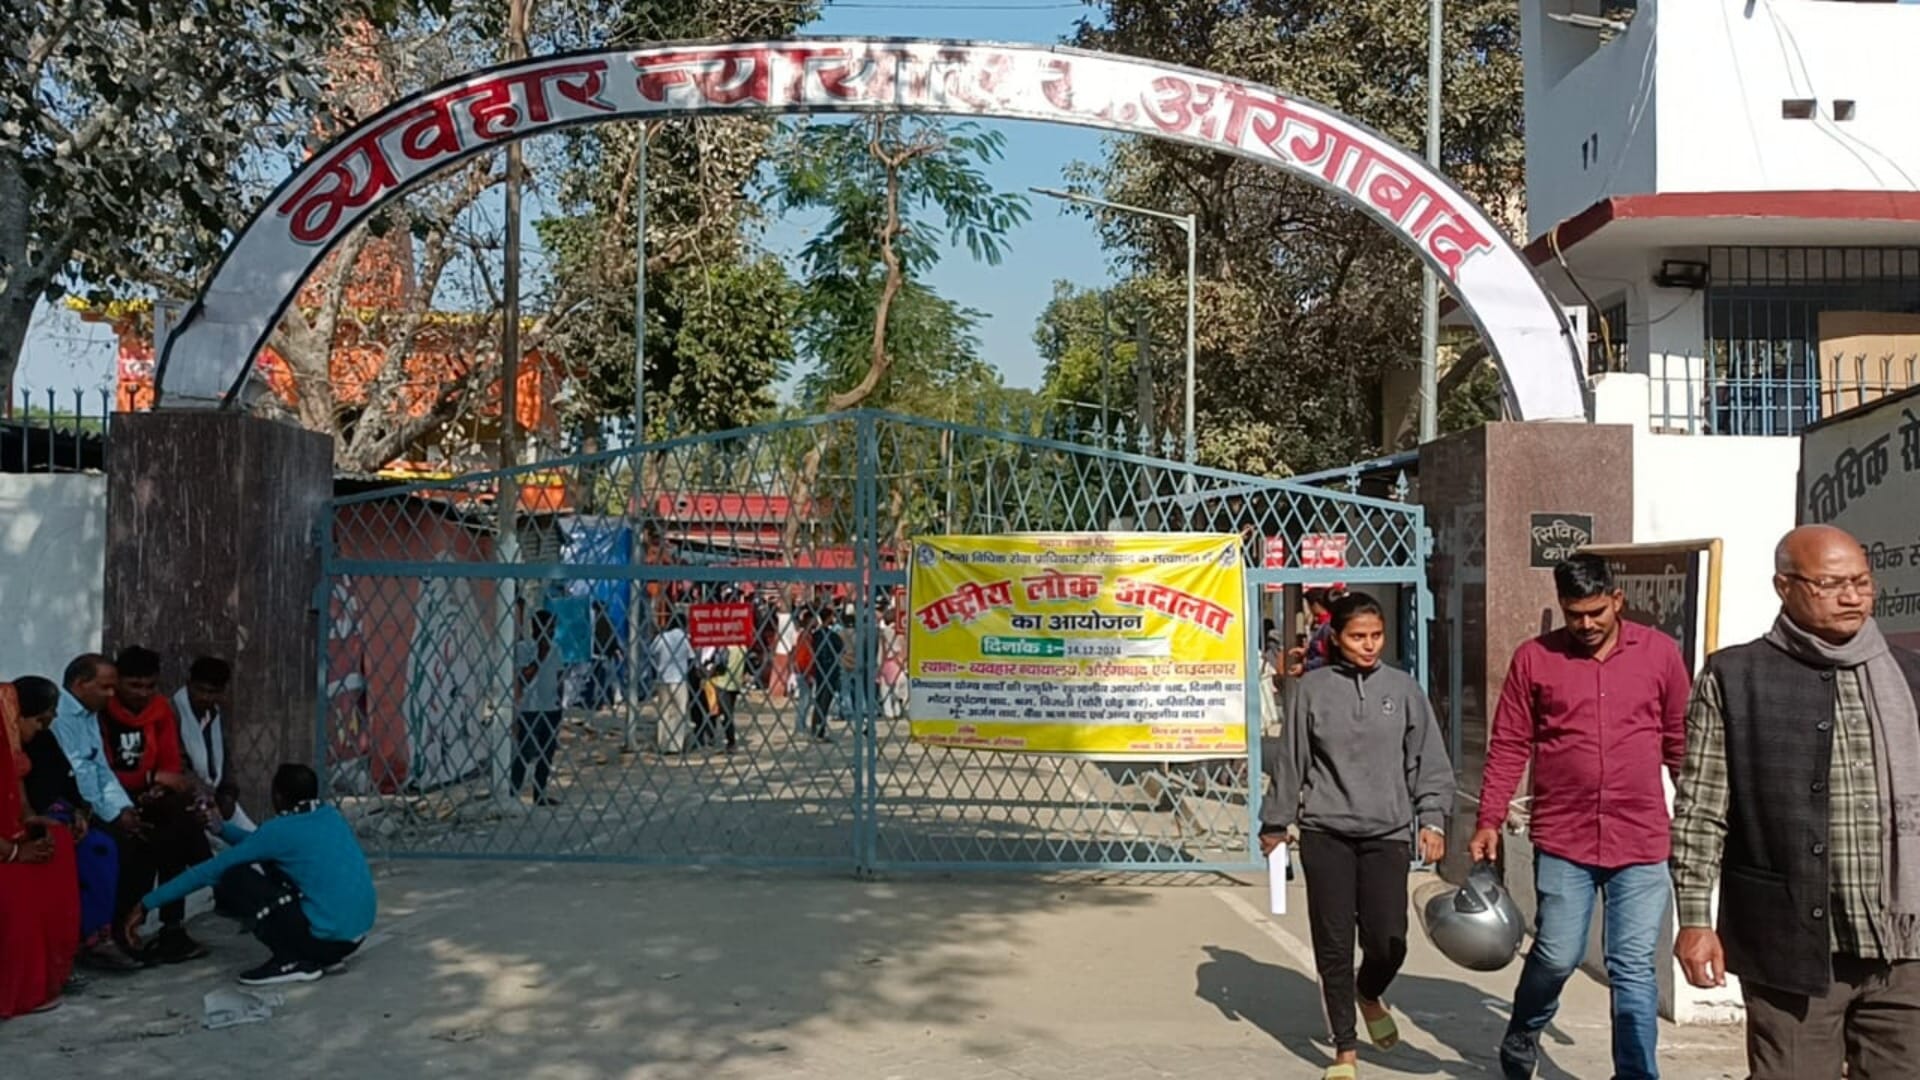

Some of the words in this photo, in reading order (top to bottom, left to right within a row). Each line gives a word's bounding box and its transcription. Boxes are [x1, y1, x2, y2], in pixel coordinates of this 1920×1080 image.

[278, 60, 616, 244] व्यवहार
[1808, 432, 1891, 524] विधिक
[915, 579, 1013, 630] राष्ट्रीय
[1021, 568, 1103, 600] लोक
[1115, 577, 1234, 635] अदालत
[1011, 614, 1041, 630] का
[1047, 610, 1143, 630] आयोजन
[983, 636, 1041, 654] दिनांक
[969, 662, 1016, 677] व्यवहार
[1085, 660, 1148, 677] औरंगाबाद
